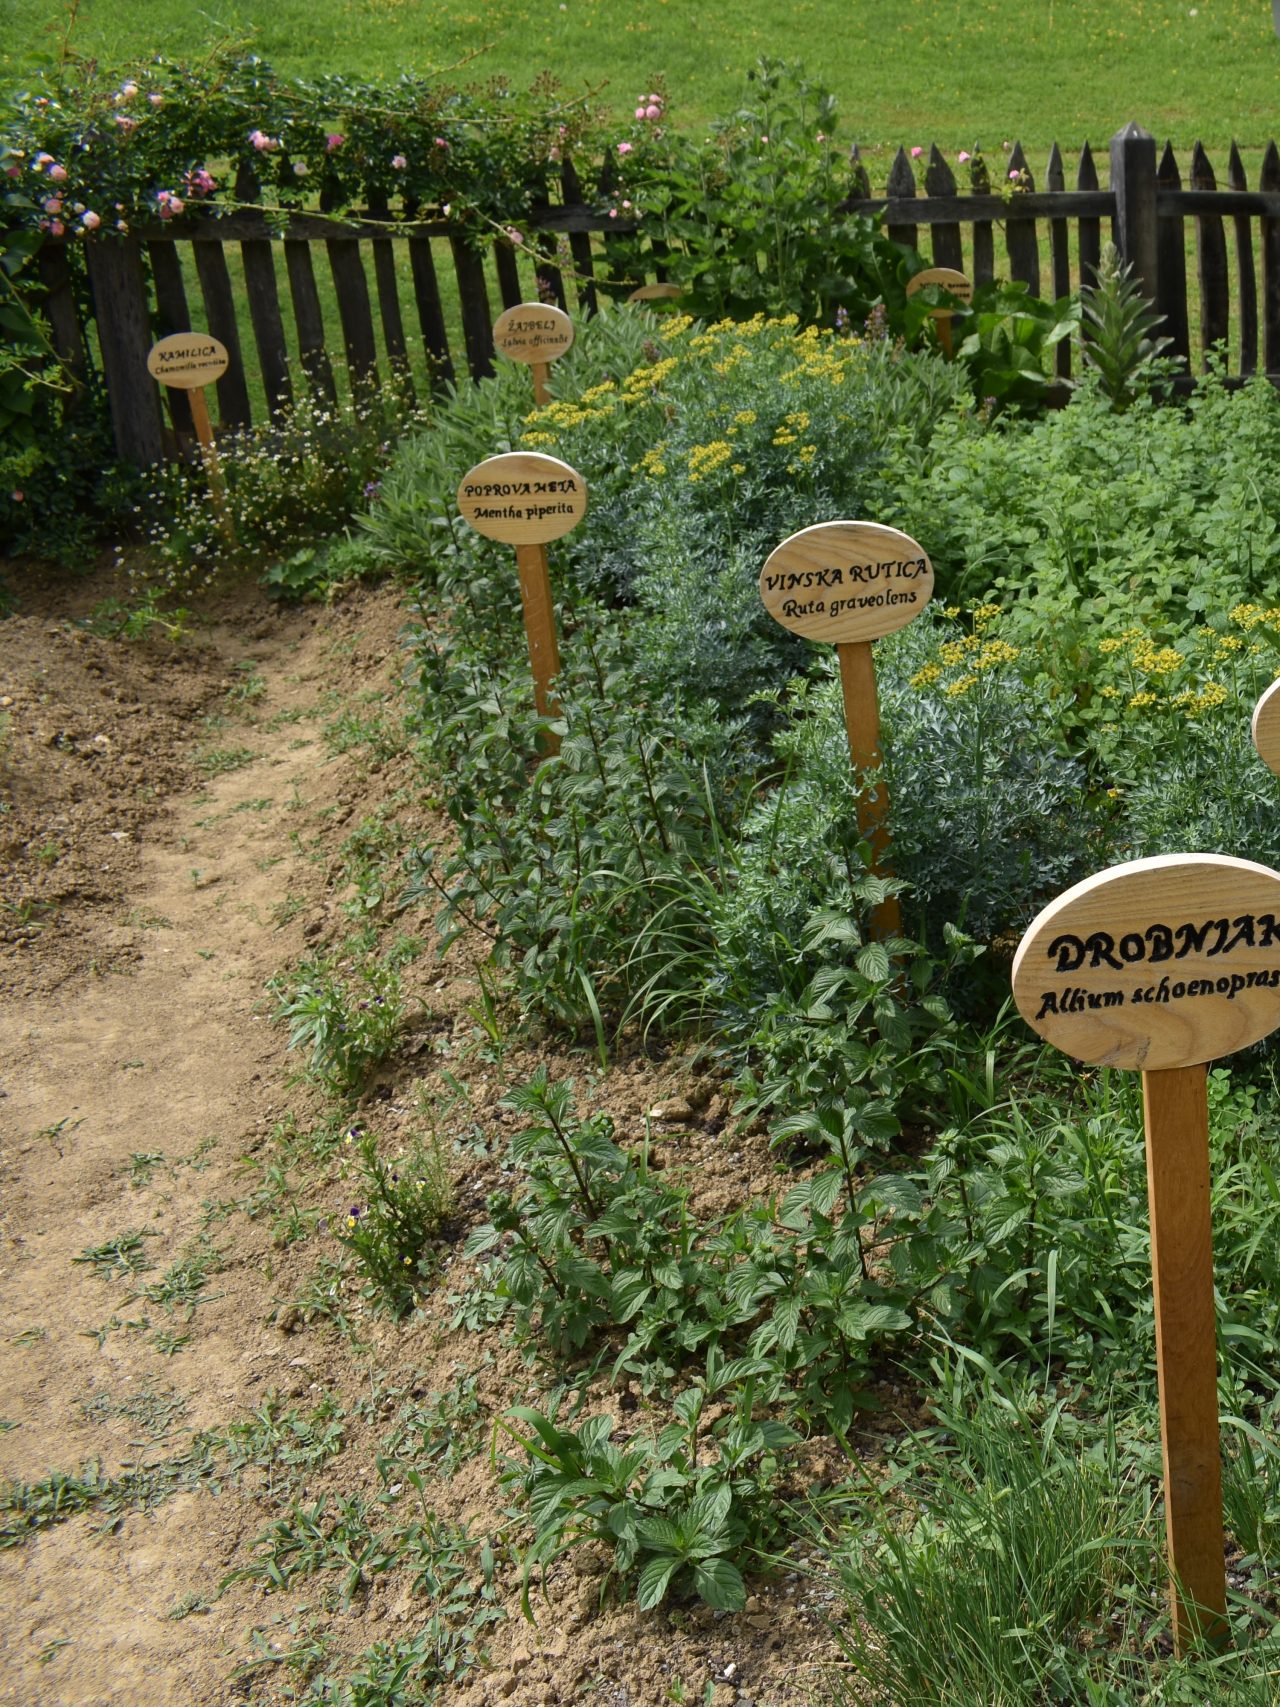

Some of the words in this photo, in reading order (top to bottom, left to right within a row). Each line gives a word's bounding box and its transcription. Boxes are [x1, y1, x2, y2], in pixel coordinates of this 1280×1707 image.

[158, 345, 217, 362] KAMILICA
[464, 482, 532, 498] POPROVA
[534, 479, 578, 494] META
[473, 504, 523, 519] Mentha
[525, 502, 575, 520] piperita
[765, 567, 845, 592] VINSKA
[849, 557, 929, 584] RUTICA
[781, 598, 826, 619] Ruta
[829, 588, 918, 618] graveolens
[1034, 987, 1125, 1021] Allium
